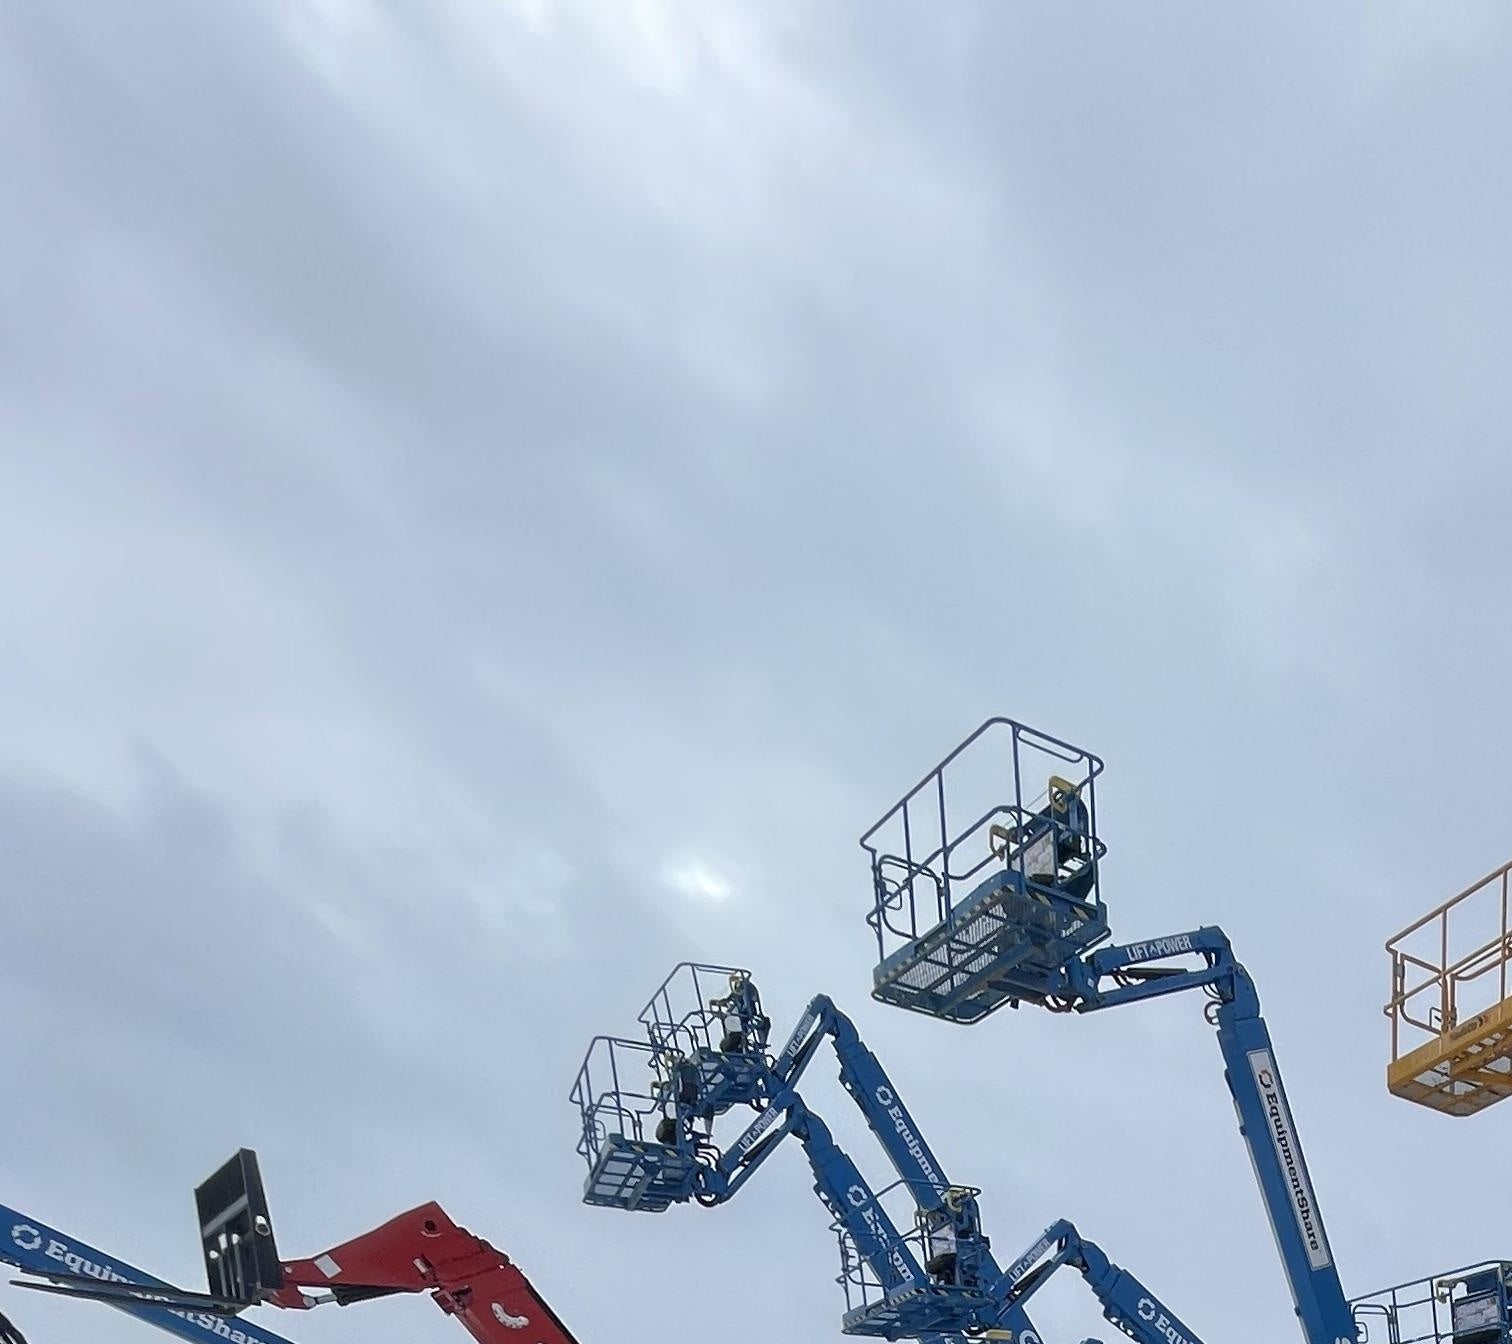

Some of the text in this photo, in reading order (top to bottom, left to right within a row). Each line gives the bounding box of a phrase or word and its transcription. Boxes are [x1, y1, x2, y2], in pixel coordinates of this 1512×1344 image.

[1126, 935, 1192, 961] LIFT POWER
[1266, 1091, 1319, 1251] EquipmentShare
[1008, 1261, 1025, 1282] LIFT
